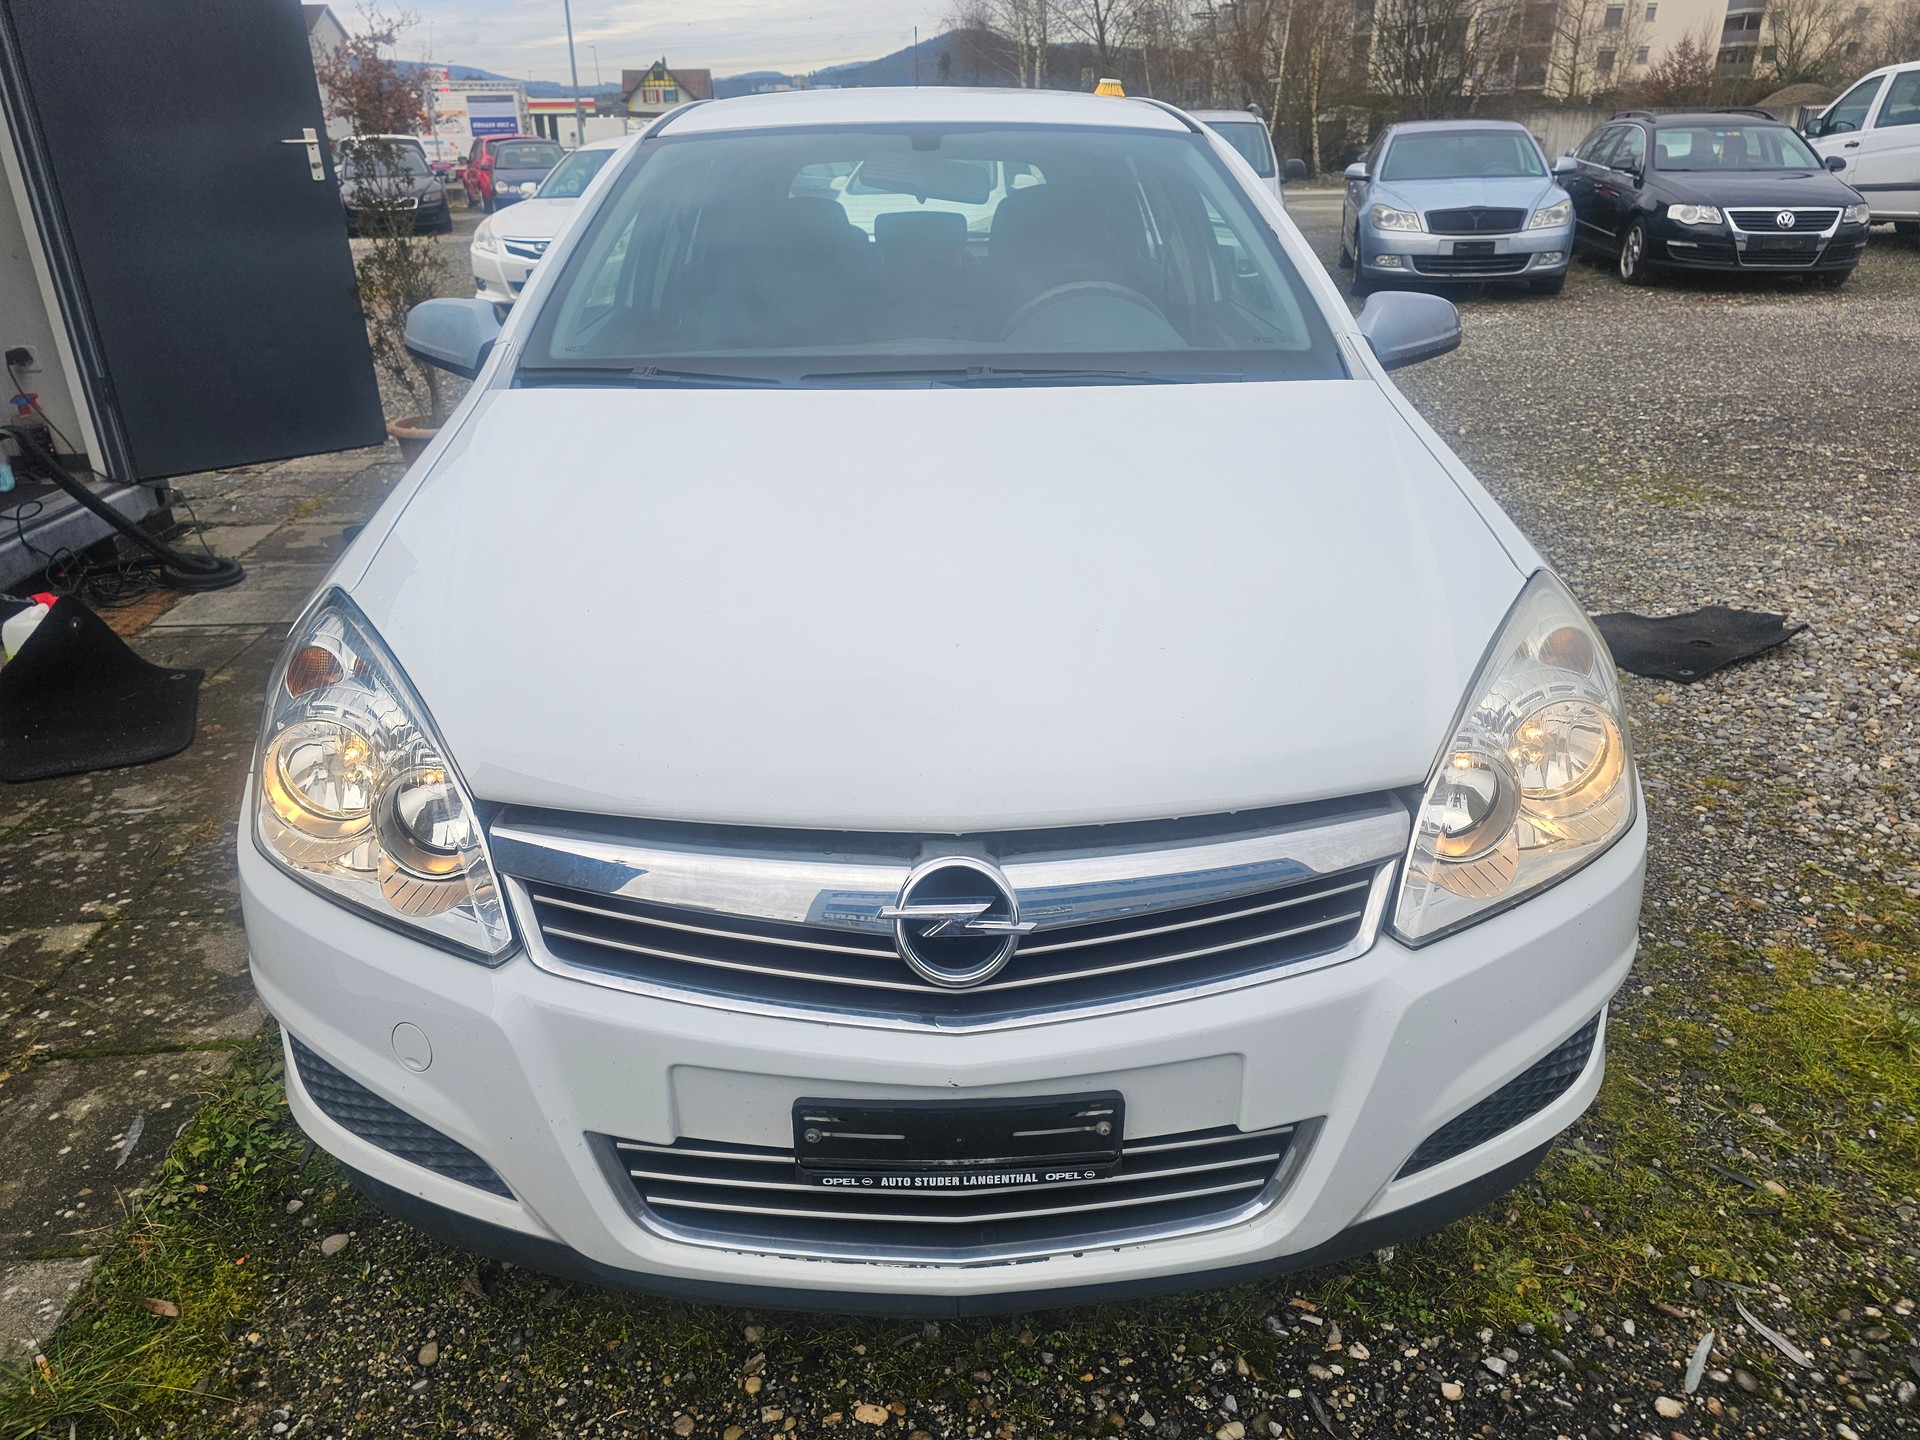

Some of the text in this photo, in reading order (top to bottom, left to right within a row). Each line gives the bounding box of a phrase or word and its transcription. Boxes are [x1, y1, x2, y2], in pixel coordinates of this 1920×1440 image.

[822, 1171, 1082, 1187] OPEL AUTO STUDER LANGENTHAL OPEL
